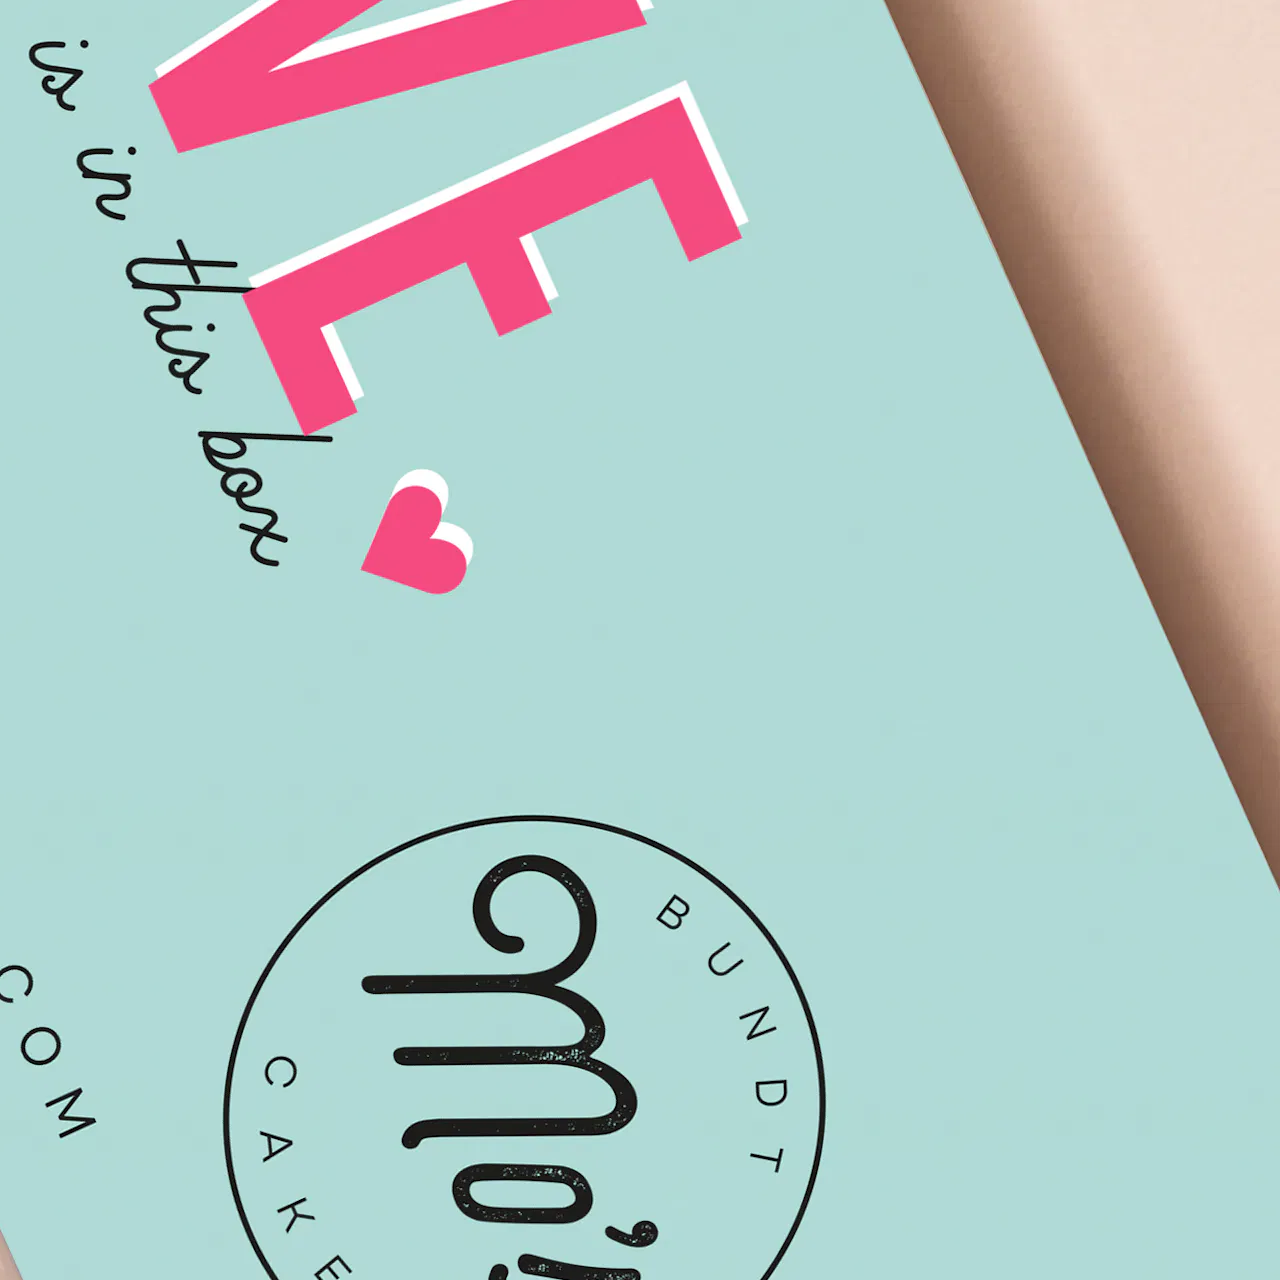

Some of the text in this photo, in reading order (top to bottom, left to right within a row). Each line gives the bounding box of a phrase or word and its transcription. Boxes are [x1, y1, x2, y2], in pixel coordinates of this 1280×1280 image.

[27, 38, 335, 568] is in this box
[654, 893, 789, 1174] BUNDT
